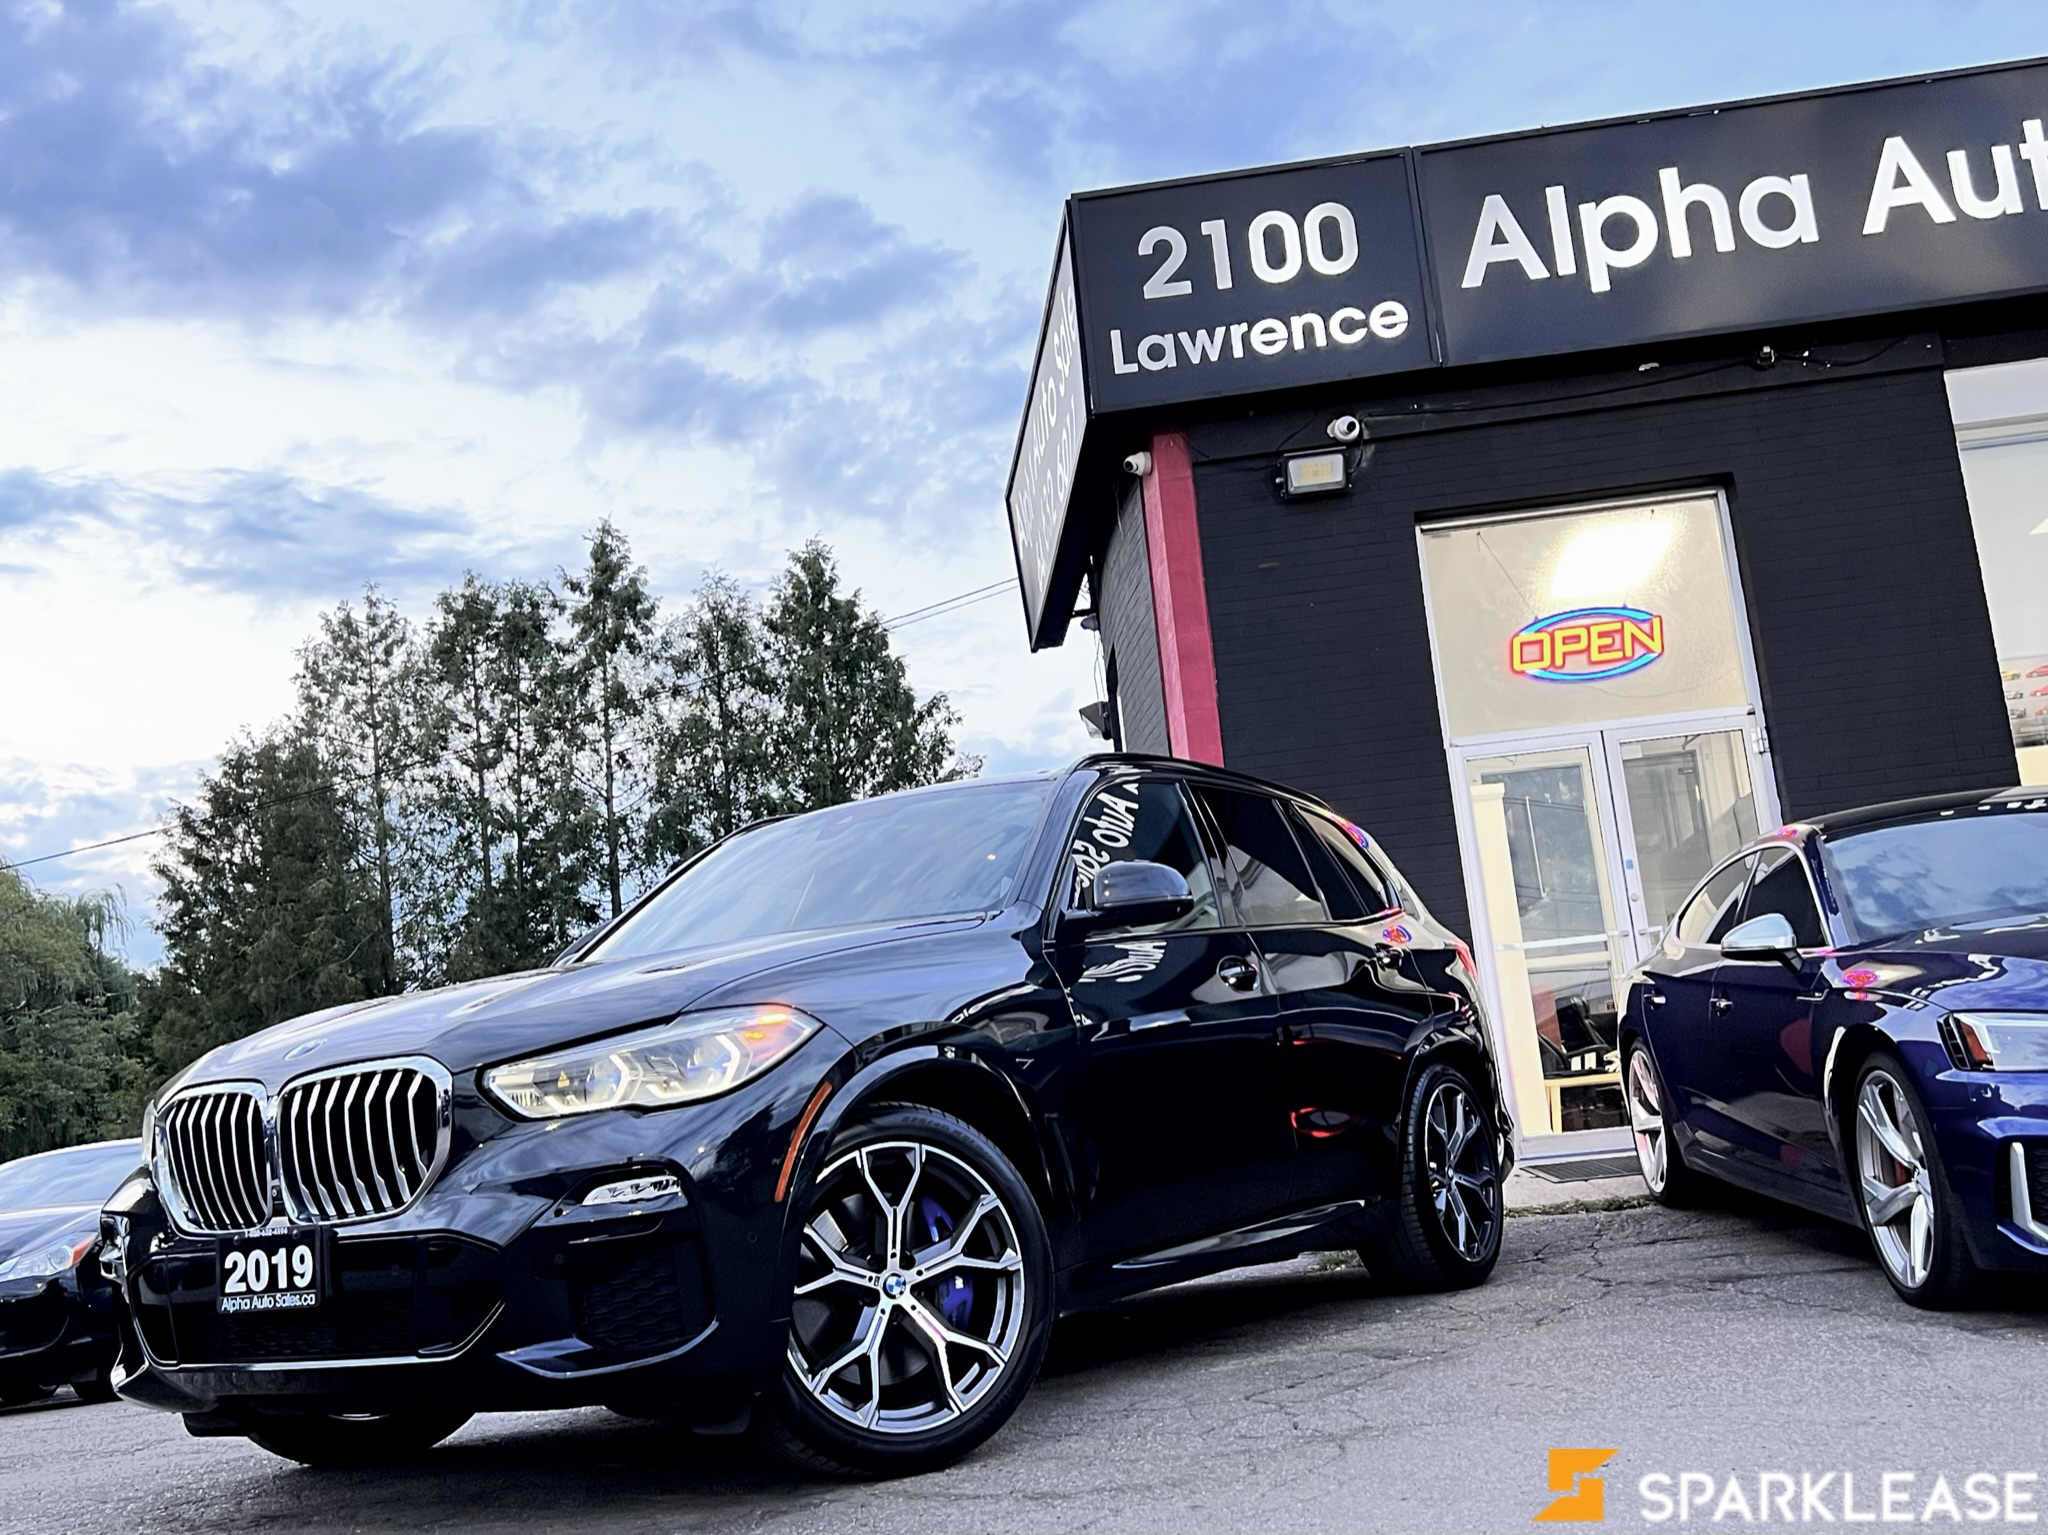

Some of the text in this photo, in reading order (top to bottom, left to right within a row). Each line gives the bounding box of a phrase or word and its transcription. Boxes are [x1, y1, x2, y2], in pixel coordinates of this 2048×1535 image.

[1461, 119, 2048, 293] Alpha Aut
[1138, 202, 1359, 300] 2100
[1110, 300, 1409, 375] Lawrence
[1511, 615, 1664, 673] OPEN
[224, 1245, 313, 1293] 2019
[221, 1292, 316, 1313] Alpha Auto Sales.ca
